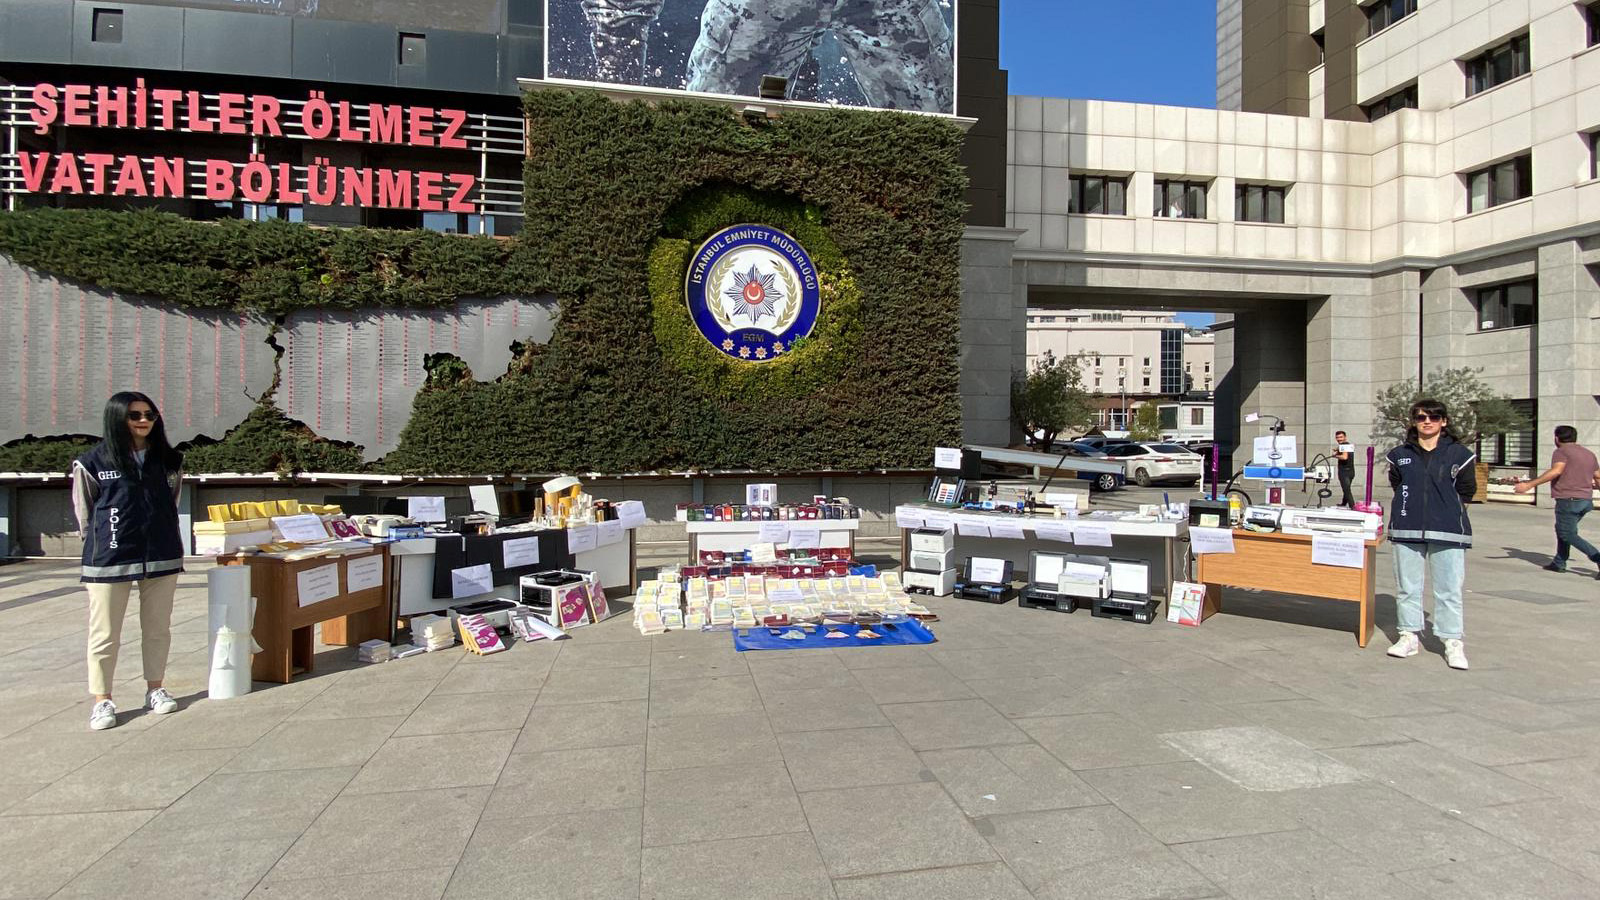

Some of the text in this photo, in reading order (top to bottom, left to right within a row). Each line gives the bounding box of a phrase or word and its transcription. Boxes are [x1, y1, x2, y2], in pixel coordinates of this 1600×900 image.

[31, 78, 468, 148] ŞEHİTLER ÖLMEZ
[18, 152, 476, 212] VATAN BÖLÜNMEZ
[691, 229, 816, 290] İSTANBUL EMNİYET MÜDÜRLÜĞÜ
[742, 333, 765, 343] EGM
[98, 470, 122, 480] GHD
[109, 508, 120, 549] POLİS
